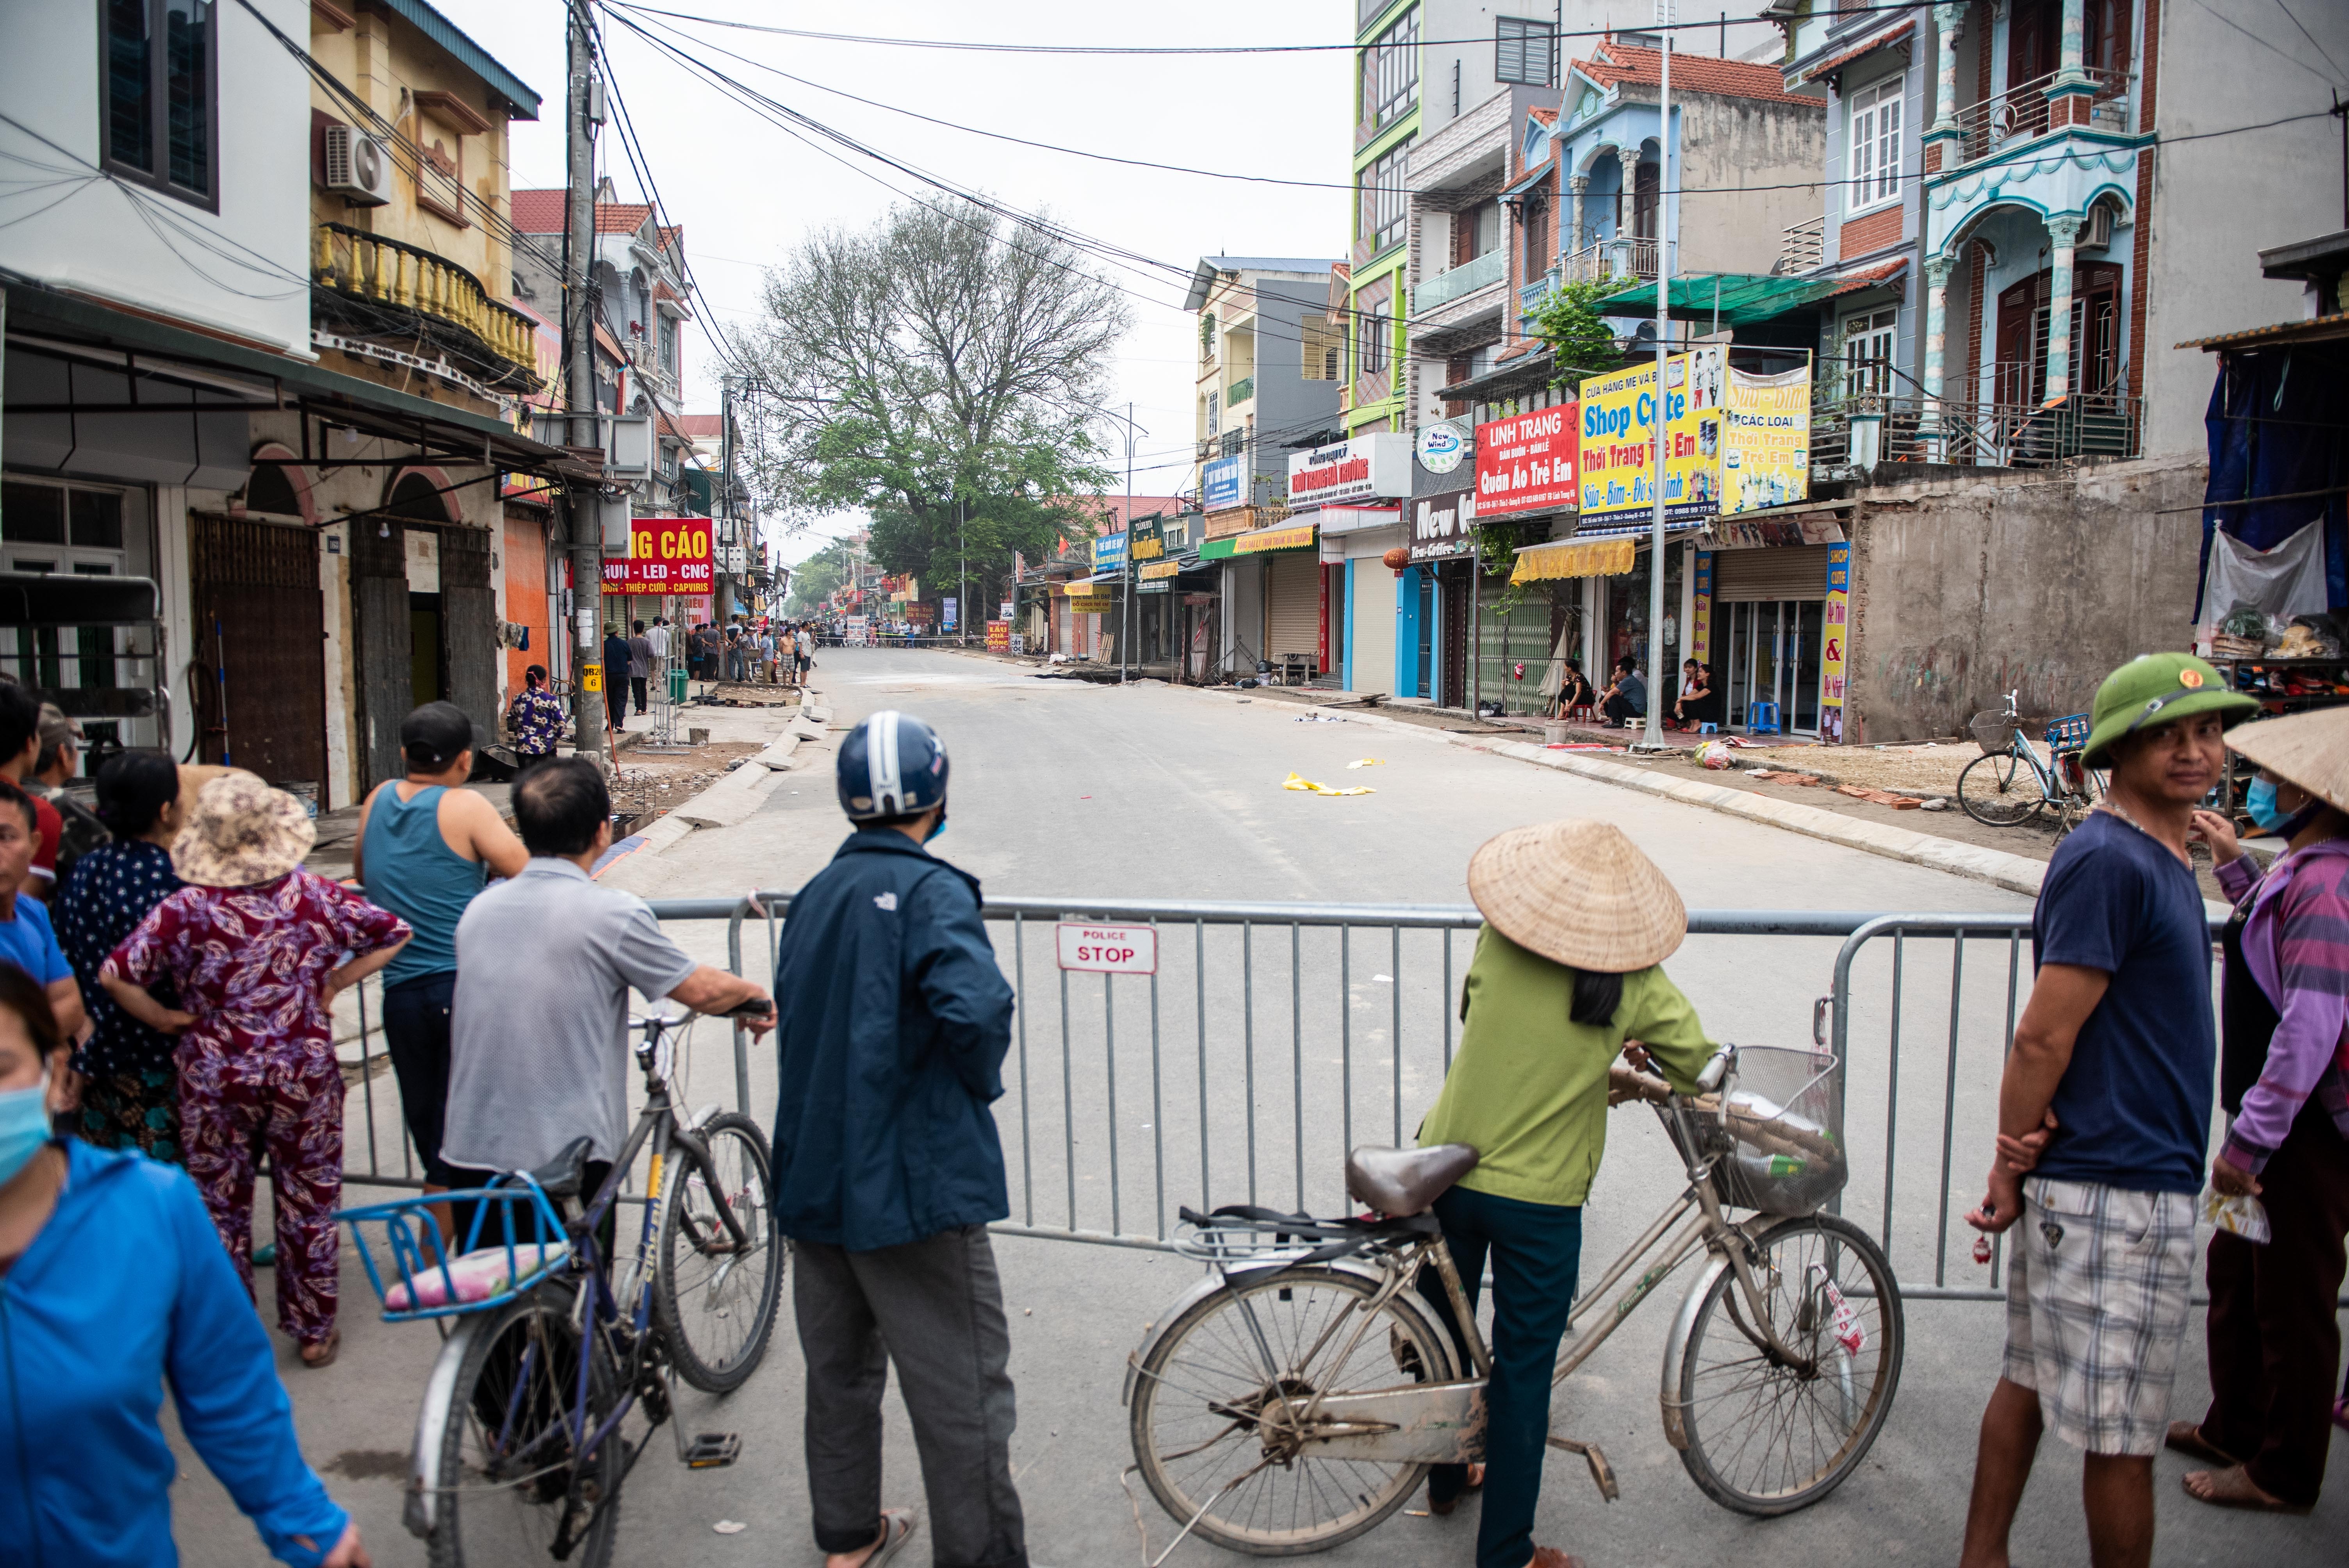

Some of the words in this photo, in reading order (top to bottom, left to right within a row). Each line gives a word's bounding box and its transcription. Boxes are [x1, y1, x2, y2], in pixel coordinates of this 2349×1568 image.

[1586, 383, 1600, 399] CỬA
[1603, 379, 1623, 394] HÀNG
[1626, 376, 1636, 390] MẸ
[1639, 371, 1649, 385] VÀ
[1490, 422, 1516, 447] LINH
[1519, 412, 1561, 440] TRANG
[1585, 403, 1631, 439] Shop
[1741, 413, 1764, 426] CÁC
[1768, 417, 1793, 429] LOẠI
[1499, 448, 1510, 461] BÁN
[1511, 445, 1526, 458] BUÔN
[1530, 442, 1542, 454] BÁN
[1542, 438, 1549, 452] LẺ
[1729, 431, 1758, 446] Thời
[1763, 433, 1802, 448] Trang
[1308, 449, 1325, 465] TỔNG
[1326, 450, 1338, 462] ĐẠI
[1338, 444, 1347, 458] LÝ
[1583, 445, 1606, 474] Thời
[1610, 444, 1644, 469] Trang
[1675, 432, 1695, 459] Em
[1770, 451, 1789, 463] Em
[1292, 469, 1305, 493] THỜI
[1306, 469, 1327, 490] TRANG
[1328, 462, 1338, 486] HÀ
[1338, 454, 1368, 483] TRƯỜNG
[1481, 466, 1509, 495] Quần
[1512, 460, 1527, 490] Áo
[1531, 459, 1550, 486] Trẻ
[1553, 457, 1572, 483] Em
[1665, 471, 1683, 499] inh
[1417, 501, 1455, 540] New
[661, 525, 707, 559] CÁO
[1112, 539, 1116, 549] XE
[1830, 549, 1848, 563] SHOP
[643, 565, 667, 579] LED
[681, 564, 709, 579] CNC
[1831, 570, 1846, 584] CUTE
[626, 581, 647, 594] THIỆP
[649, 581, 667, 592] CƯỚI
[674, 583, 708, 592] CAPVIRIS
[989, 624, 1007, 633] LẨU
[1826, 638, 1841, 661] &
[1083, 930, 1126, 941] POLICE
[1078, 946, 1134, 963] STOP
